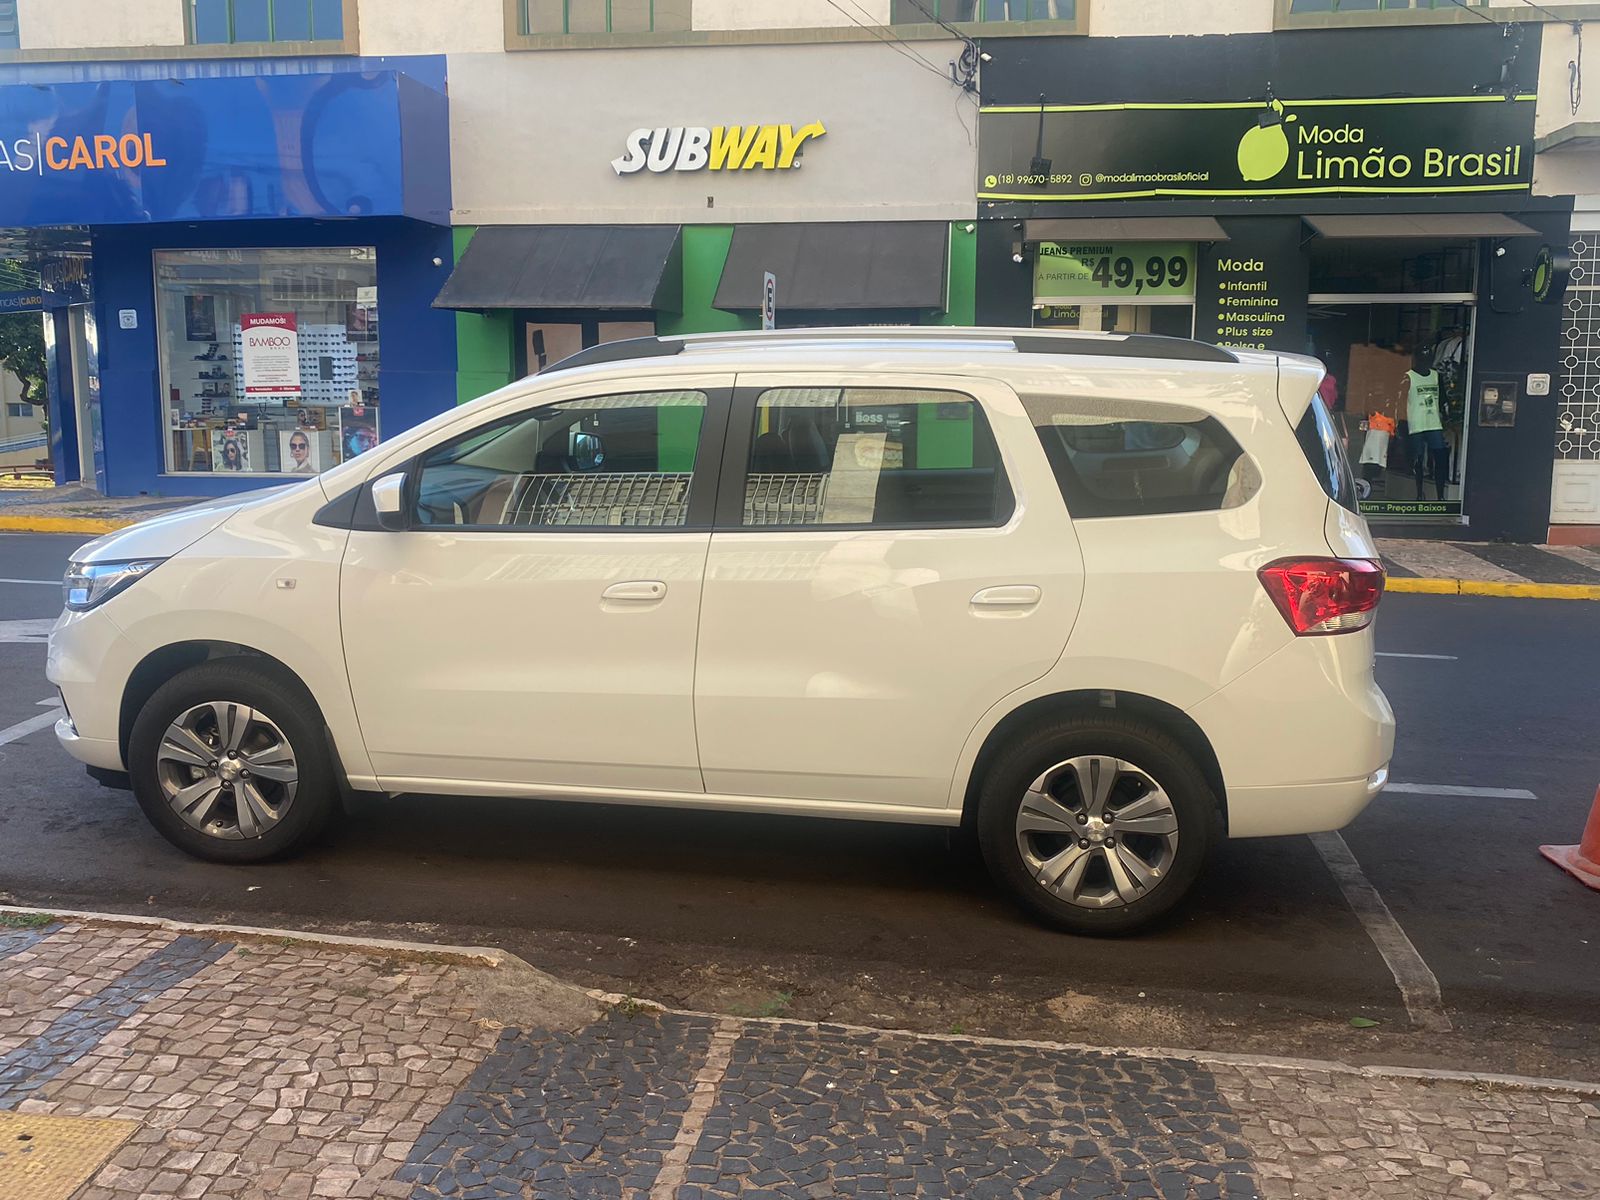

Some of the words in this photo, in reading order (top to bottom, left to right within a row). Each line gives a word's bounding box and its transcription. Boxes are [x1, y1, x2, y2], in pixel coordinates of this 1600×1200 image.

[1298, 124, 1364, 144] Moda
[45, 133, 167, 171] CAROL
[611, 120, 827, 175] SUBWAY
[1297, 147, 1412, 180] Limão
[1424, 145, 1521, 178] Brasil
[998, 174, 1014, 185] (18)
[1017, 174, 1073, 185] 99670-5892
[1095, 172, 1210, 183] @modalimaobrasiloficial
[1039, 247, 1068, 256] JEANS
[1070, 246, 1113, 255] PREMIUM
[1217, 258, 1264, 272] Moda
[1078, 272, 1089, 280] DE
[1081, 258, 1095, 267] R$
[1092, 256, 1188, 295] 49,99
[1227, 281, 1267, 291] Infantil
[1226, 297, 1279, 307] Feminina
[1226, 312, 1285, 322] Masculina
[1225, 327, 1248, 337] Plus
[1252, 327, 1273, 337] size
[249, 336, 290, 347] BAMBOO
[1387, 504, 1417, 514] Preços
[1418, 503, 1447, 512] Baixos
